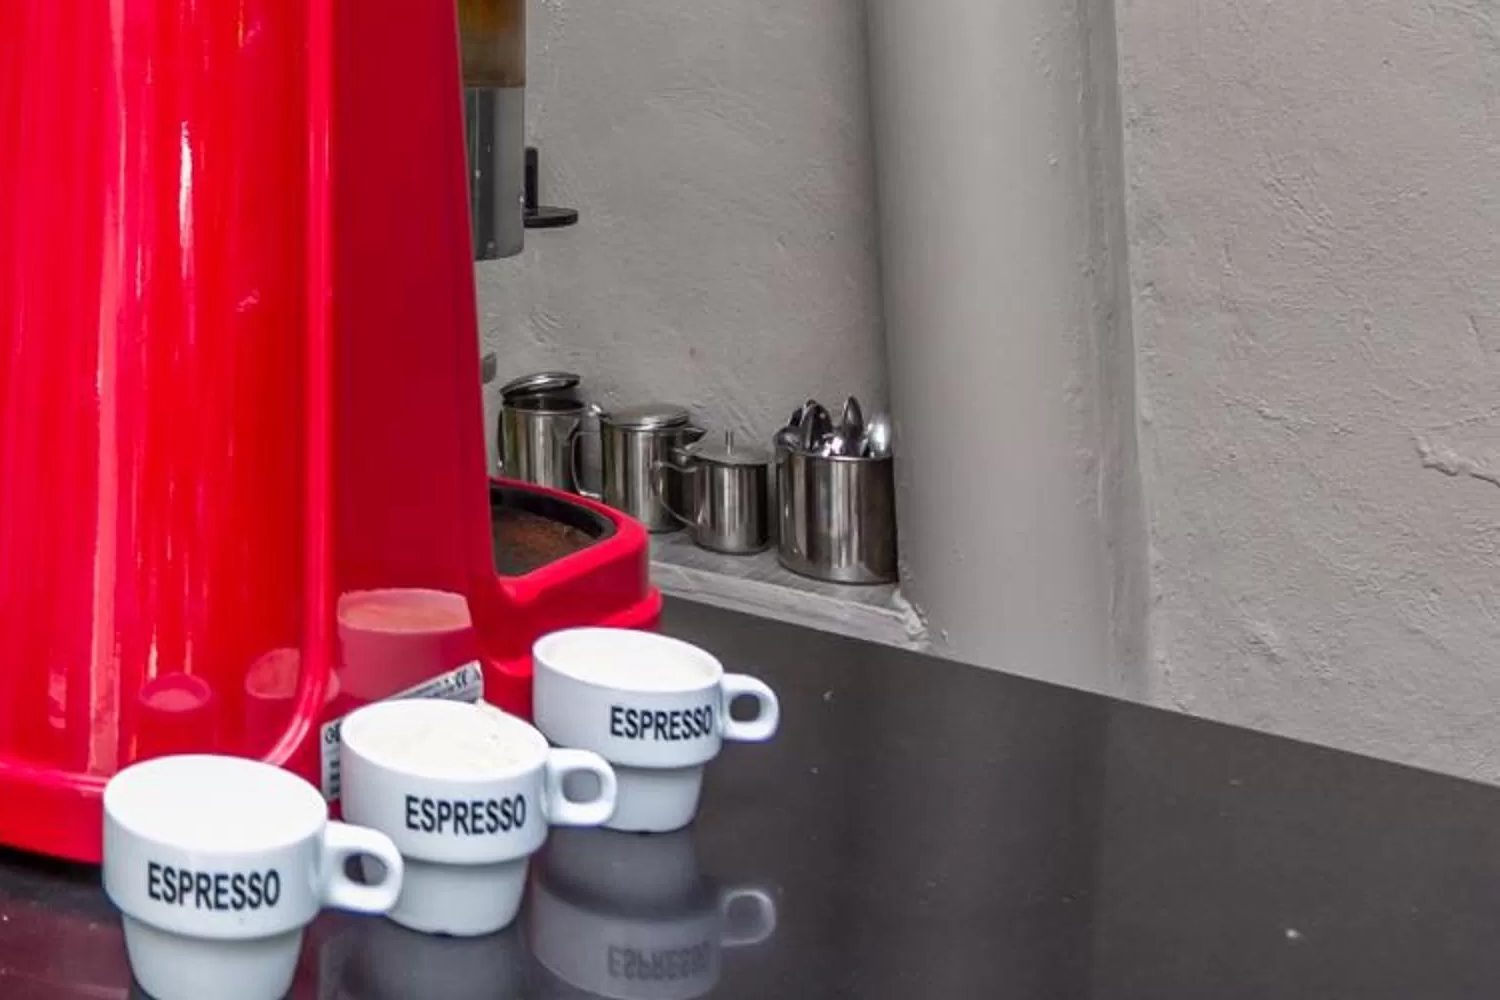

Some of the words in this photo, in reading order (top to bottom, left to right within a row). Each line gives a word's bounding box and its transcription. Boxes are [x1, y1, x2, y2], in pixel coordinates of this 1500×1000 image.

[610, 704, 713, 741] ESPRESSO
[405, 793, 526, 835] ESPRESSO
[148, 860, 280, 911] ESPRESSO
